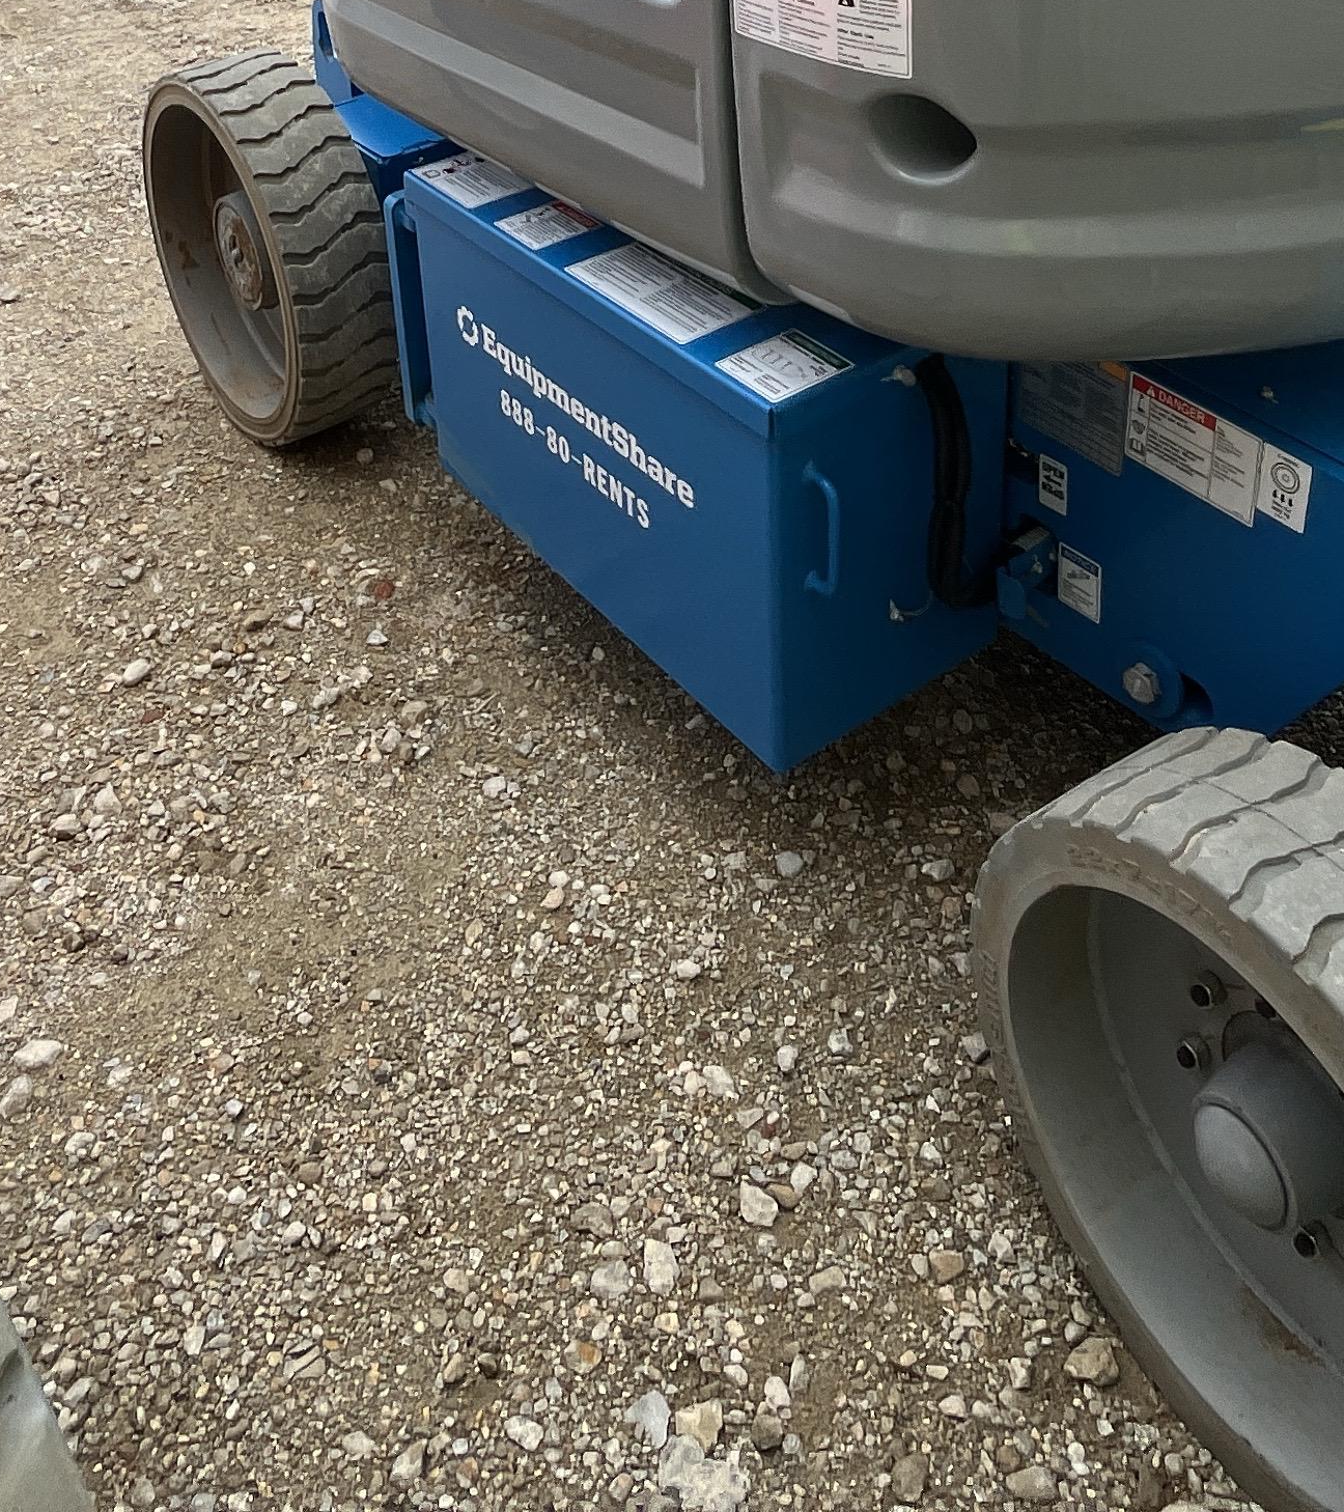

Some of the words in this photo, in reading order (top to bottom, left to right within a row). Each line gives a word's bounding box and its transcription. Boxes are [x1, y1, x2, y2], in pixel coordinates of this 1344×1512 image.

[480, 323, 695, 509] EquipmentShare
[500, 389, 650, 529] 888-80-RENTS
[1158, 391, 1207, 423] DANGER
